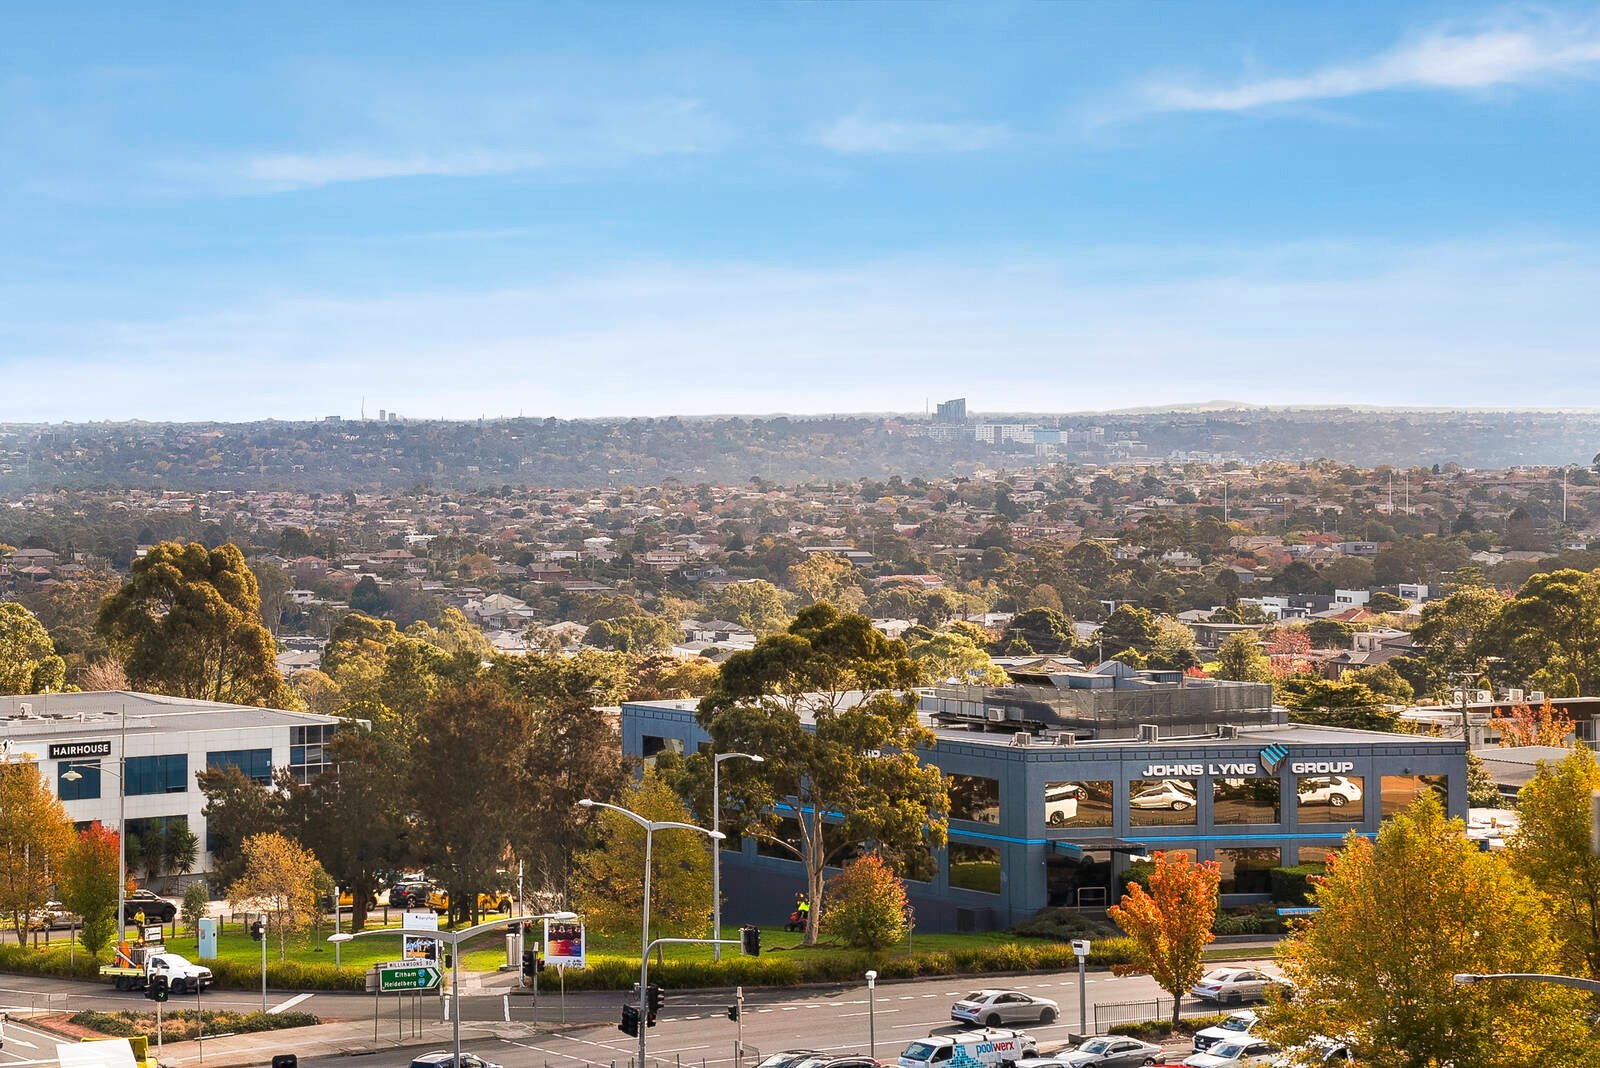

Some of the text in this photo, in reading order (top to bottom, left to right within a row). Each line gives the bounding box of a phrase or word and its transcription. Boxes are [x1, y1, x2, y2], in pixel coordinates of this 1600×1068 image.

[53, 744, 109, 756] HAIRHOUSE
[1142, 762, 1354, 777] JOHNS LYNG GROUP
[384, 980, 417, 988] Heidelberg
[976, 1041, 1015, 1058] poolwerx
